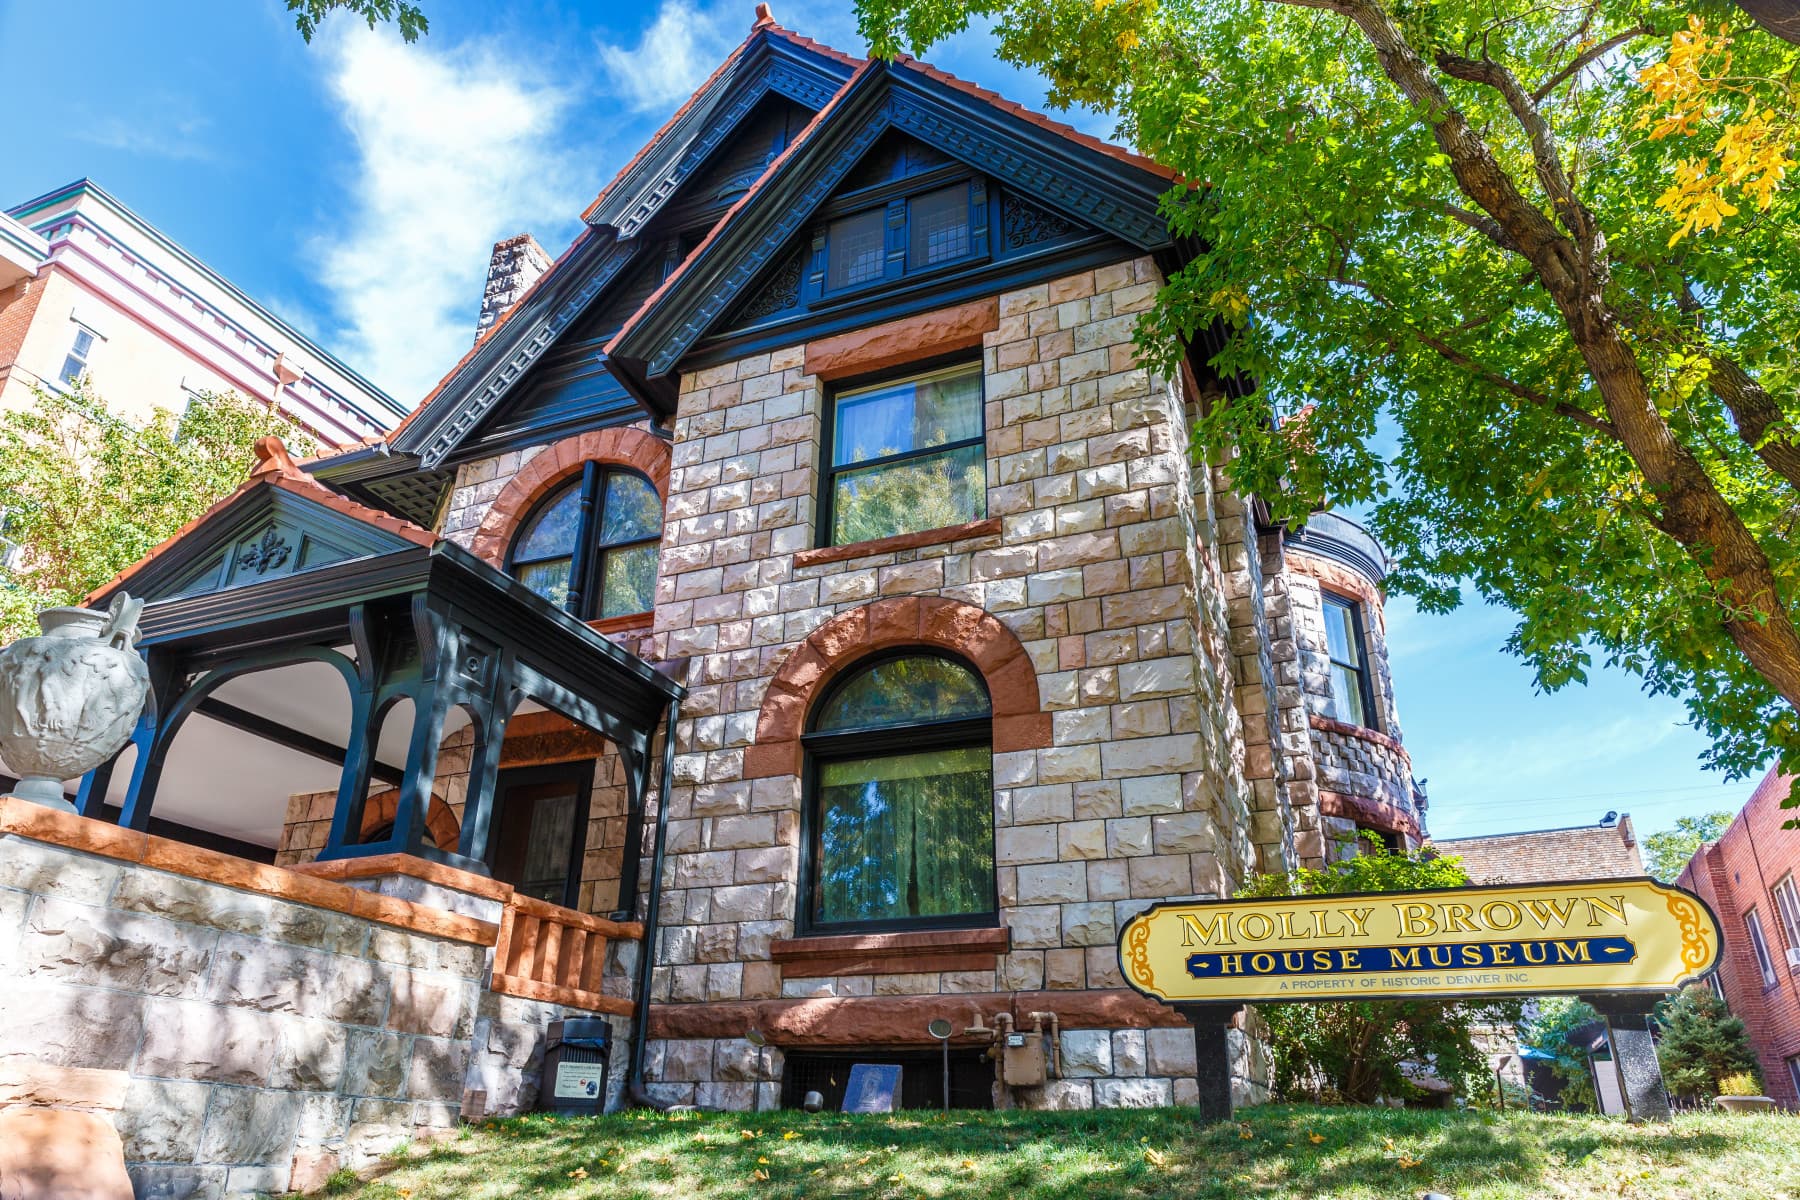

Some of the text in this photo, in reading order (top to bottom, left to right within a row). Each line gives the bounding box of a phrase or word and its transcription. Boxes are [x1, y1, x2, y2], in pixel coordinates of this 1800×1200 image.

[1177, 895, 1628, 947] MOLLY BROWN
[1220, 941, 1592, 974] HOUSE MUSEUM
[1280, 981, 1289, 990] A
[1292, 979, 1356, 990] PROPERTY
[1360, 978, 1377, 987] OF
[1381, 976, 1441, 987] HISTORIC
[1446, 974, 1500, 985] DENVER
